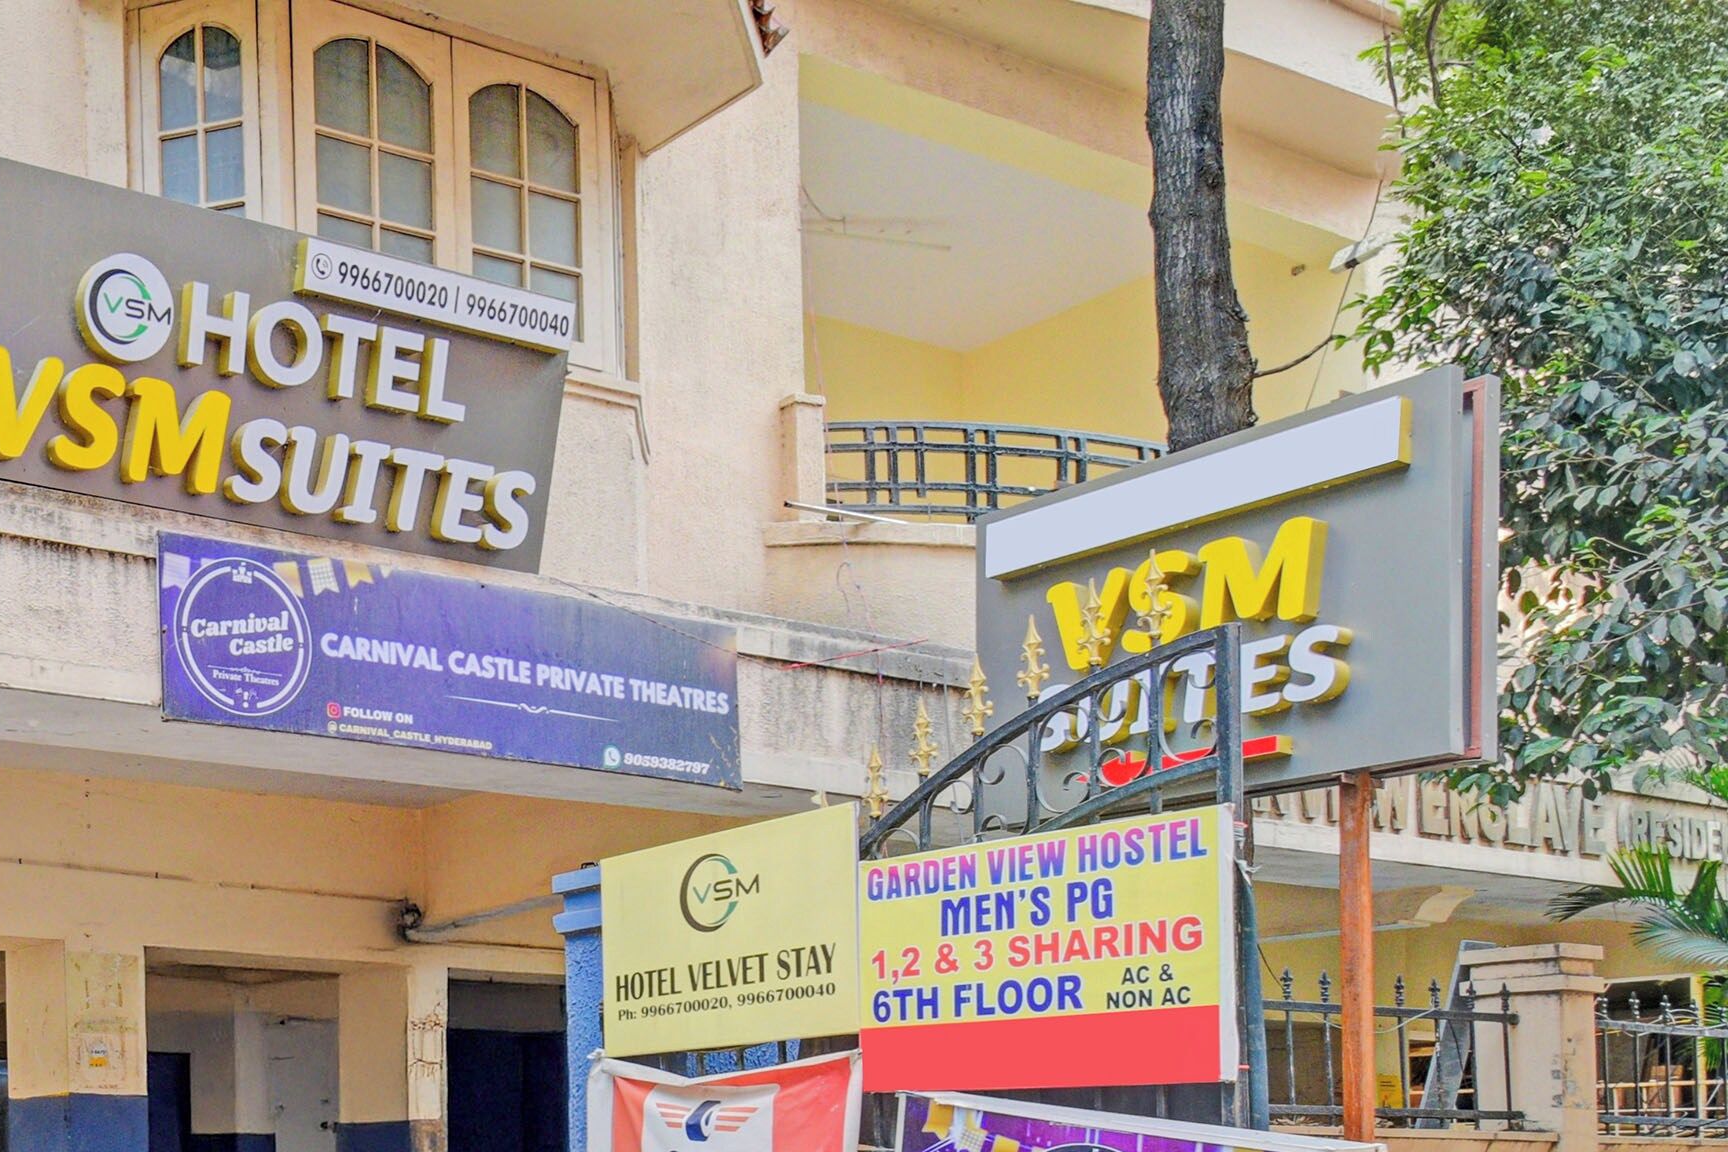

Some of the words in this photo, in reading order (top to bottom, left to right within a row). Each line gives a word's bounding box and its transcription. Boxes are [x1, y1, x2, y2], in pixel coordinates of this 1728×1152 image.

[103, 292, 171, 325] VSM
[338, 261, 448, 309] 9966700020
[466, 293, 569, 337] 9966700040
[179, 281, 466, 423] HOTEL
[224, 418, 536, 550] SUITES
[1047, 516, 1328, 672] VSM
[190, 610, 289, 638] Carnival
[229, 634, 294, 656] Castle
[212, 669, 243, 682] Private
[243, 671, 280, 687] Theatres
[320, 632, 444, 673] CARNIVAL
[448, 650, 532, 685] CASTLE
[536, 665, 626, 699] PRIVATE
[629, 678, 730, 716] THEATRES
[343, 706, 392, 723] FOLLOW
[394, 711, 414, 725] ON
[624, 753, 710, 775] 9059382797
[867, 852, 977, 902] GARDEN
[986, 839, 1067, 886] VIEW
[1077, 818, 1208, 874] HOSTEL
[692, 872, 760, 906] VSM
[940, 885, 1051, 938] MEN'S
[1067, 877, 1114, 923] PG
[872, 945, 921, 984] 1,2
[934, 942, 960, 975] &
[974, 938, 995, 971] 3
[1008, 915, 1204, 968] SHARING
[616, 967, 682, 1003] HOTEL
[688, 952, 769, 993] VELVET
[776, 942, 836, 981] STAY
[1121, 965, 1150, 985] AC
[1159, 963, 1174, 982] &
[618, 1008, 637, 1021] Ph:
[641, 996, 732, 1018] 9966700020,
[737, 982, 836, 1007] 9966700040
[872, 986, 940, 1024] 6TH
[953, 974, 1084, 1018] FLOOR
[1106, 989, 1153, 1010] NON
[1161, 986, 1191, 1006] AC
